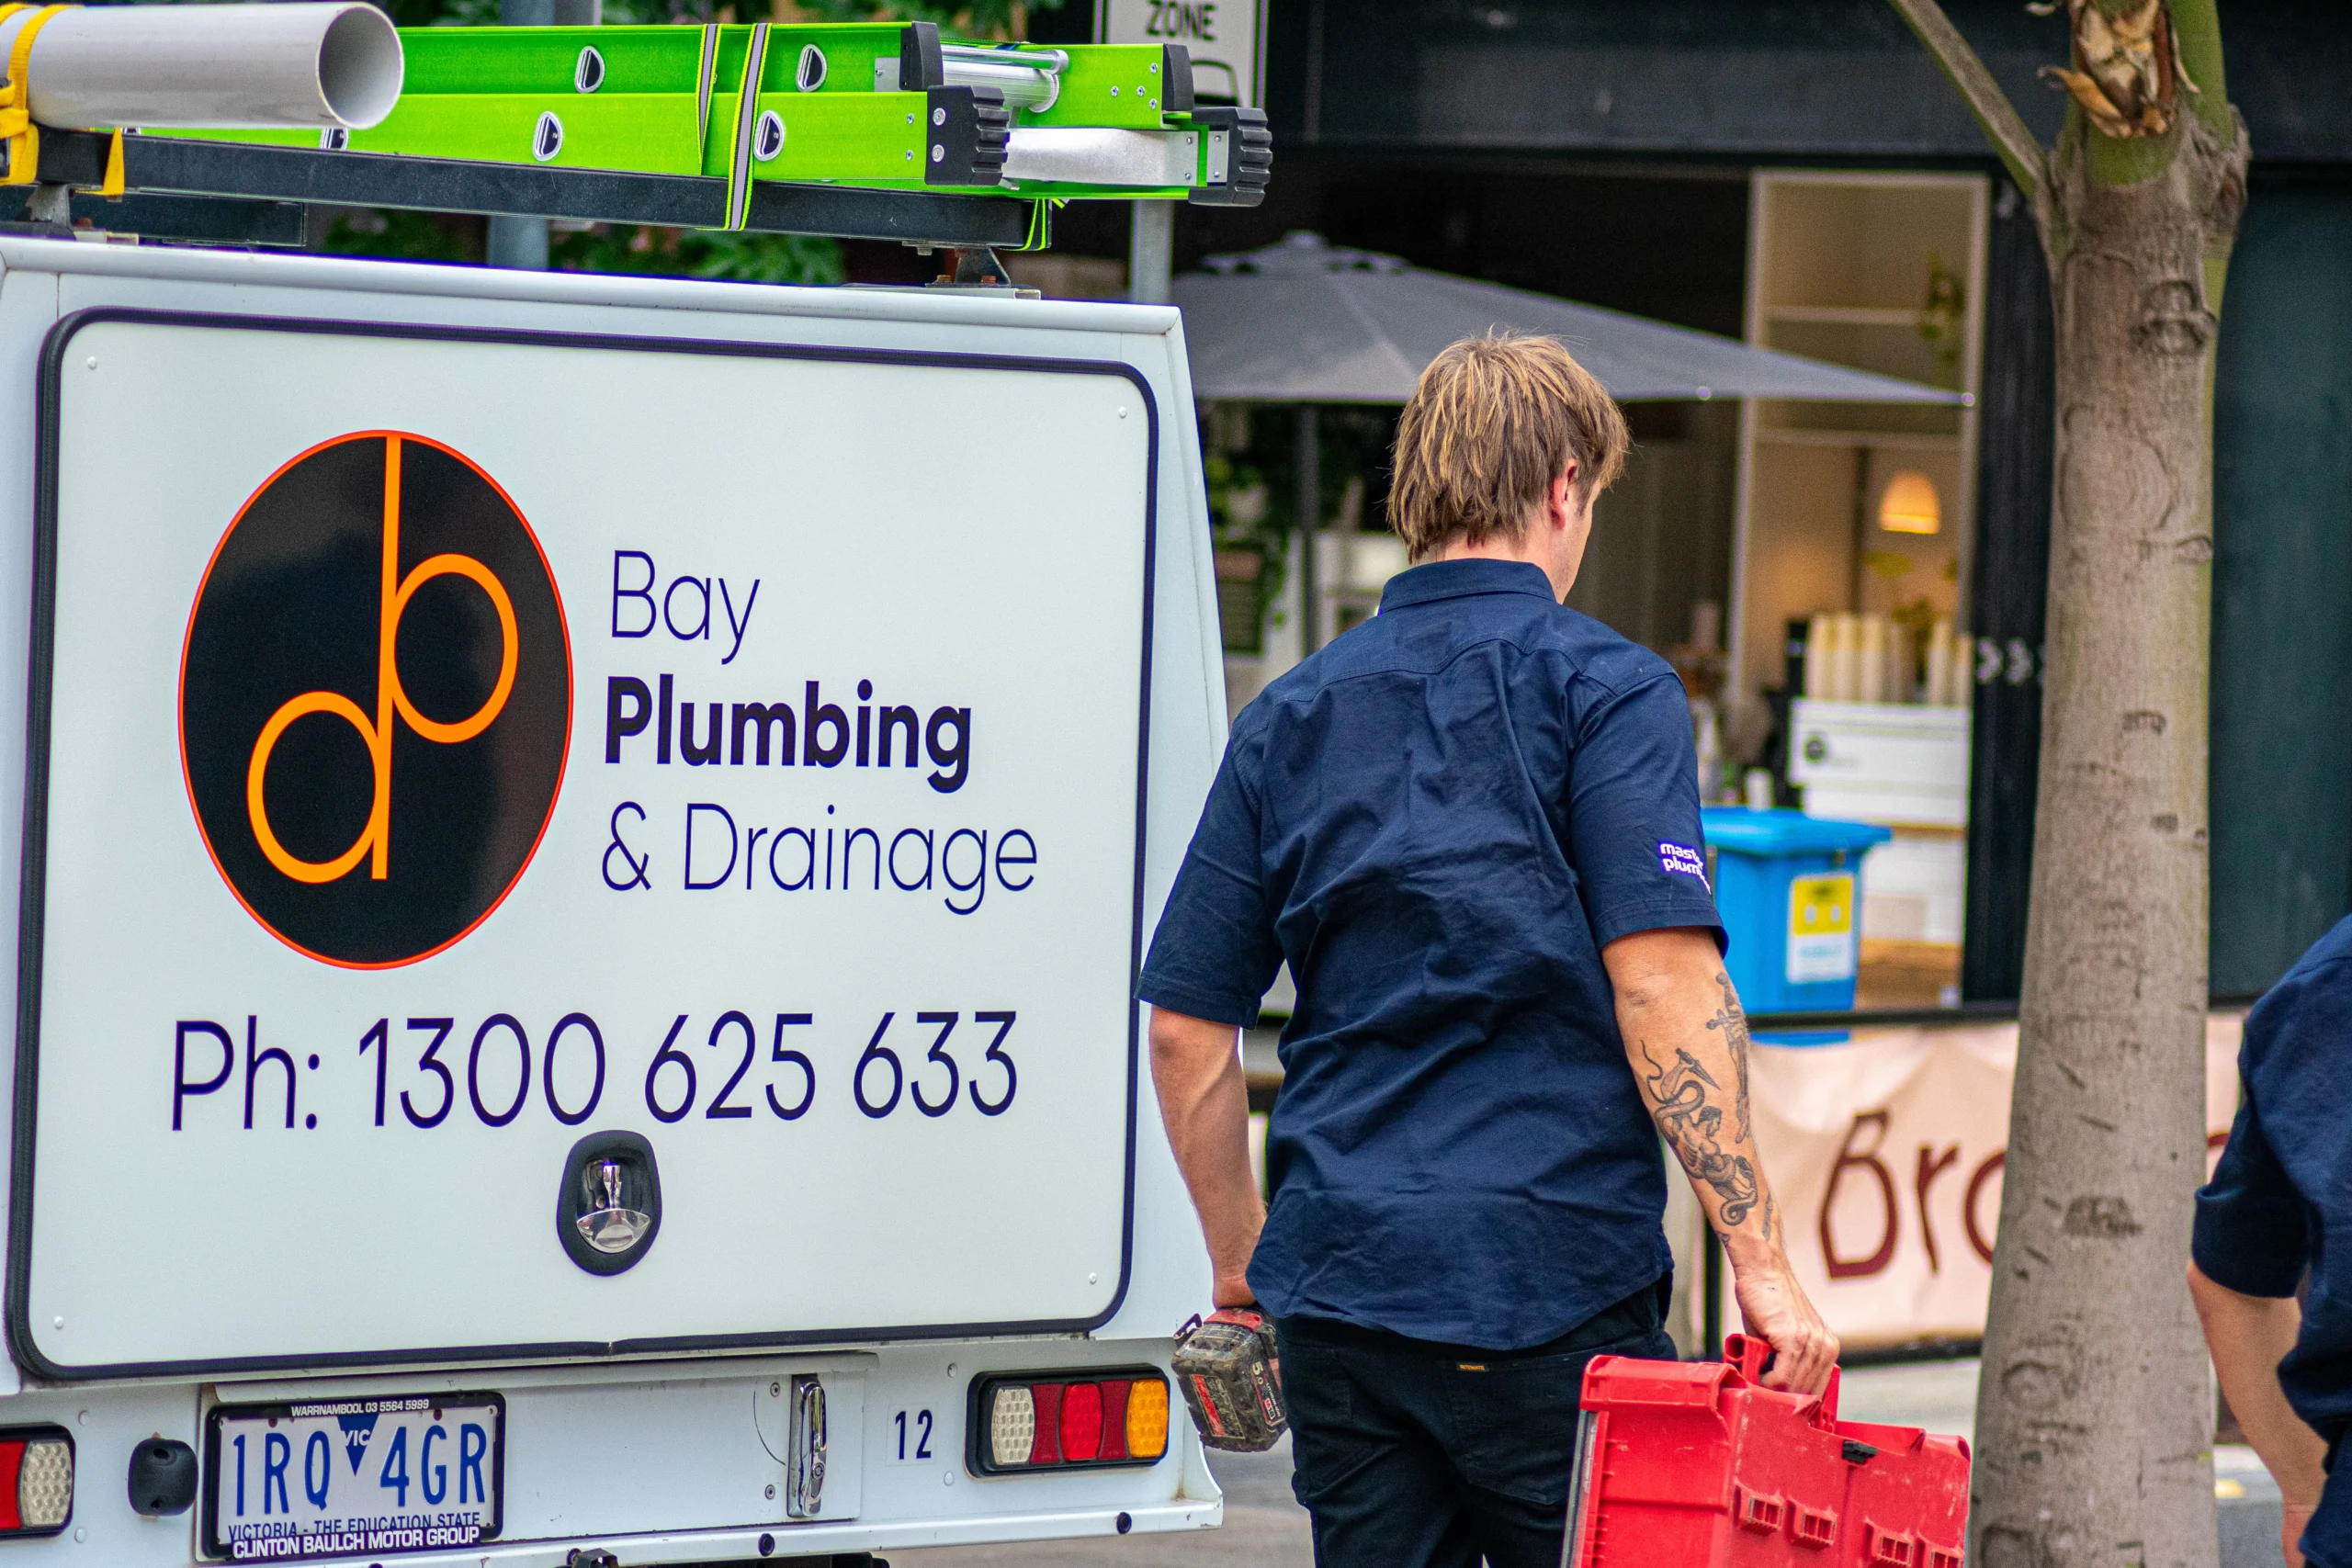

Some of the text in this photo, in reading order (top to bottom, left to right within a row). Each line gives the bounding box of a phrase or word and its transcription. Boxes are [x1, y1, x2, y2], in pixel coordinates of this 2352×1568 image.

[1147, 1, 1216, 41] ZONE
[611, 549, 761, 665] Bay
[605, 673, 972, 794] Plumbing
[602, 801, 1038, 916] & Drainage
[172, 1010, 1018, 1131] Ph: 1300 625 633
[290, 1398, 430, 1417] WARRNAMBOOL 03 5564 5999
[341, 1429, 371, 1447] VIC
[895, 1409, 933, 1461] 12
[232, 1423, 488, 1517] 1RQ 4GR
[228, 1521, 299, 1542] VICTORIA
[314, 1518, 343, 1535] THE
[348, 1514, 432, 1532] EDUCATION
[437, 1511, 481, 1527] STATE
[232, 1526, 481, 1559] CLINTON BAULCH MOTOR GROUP
